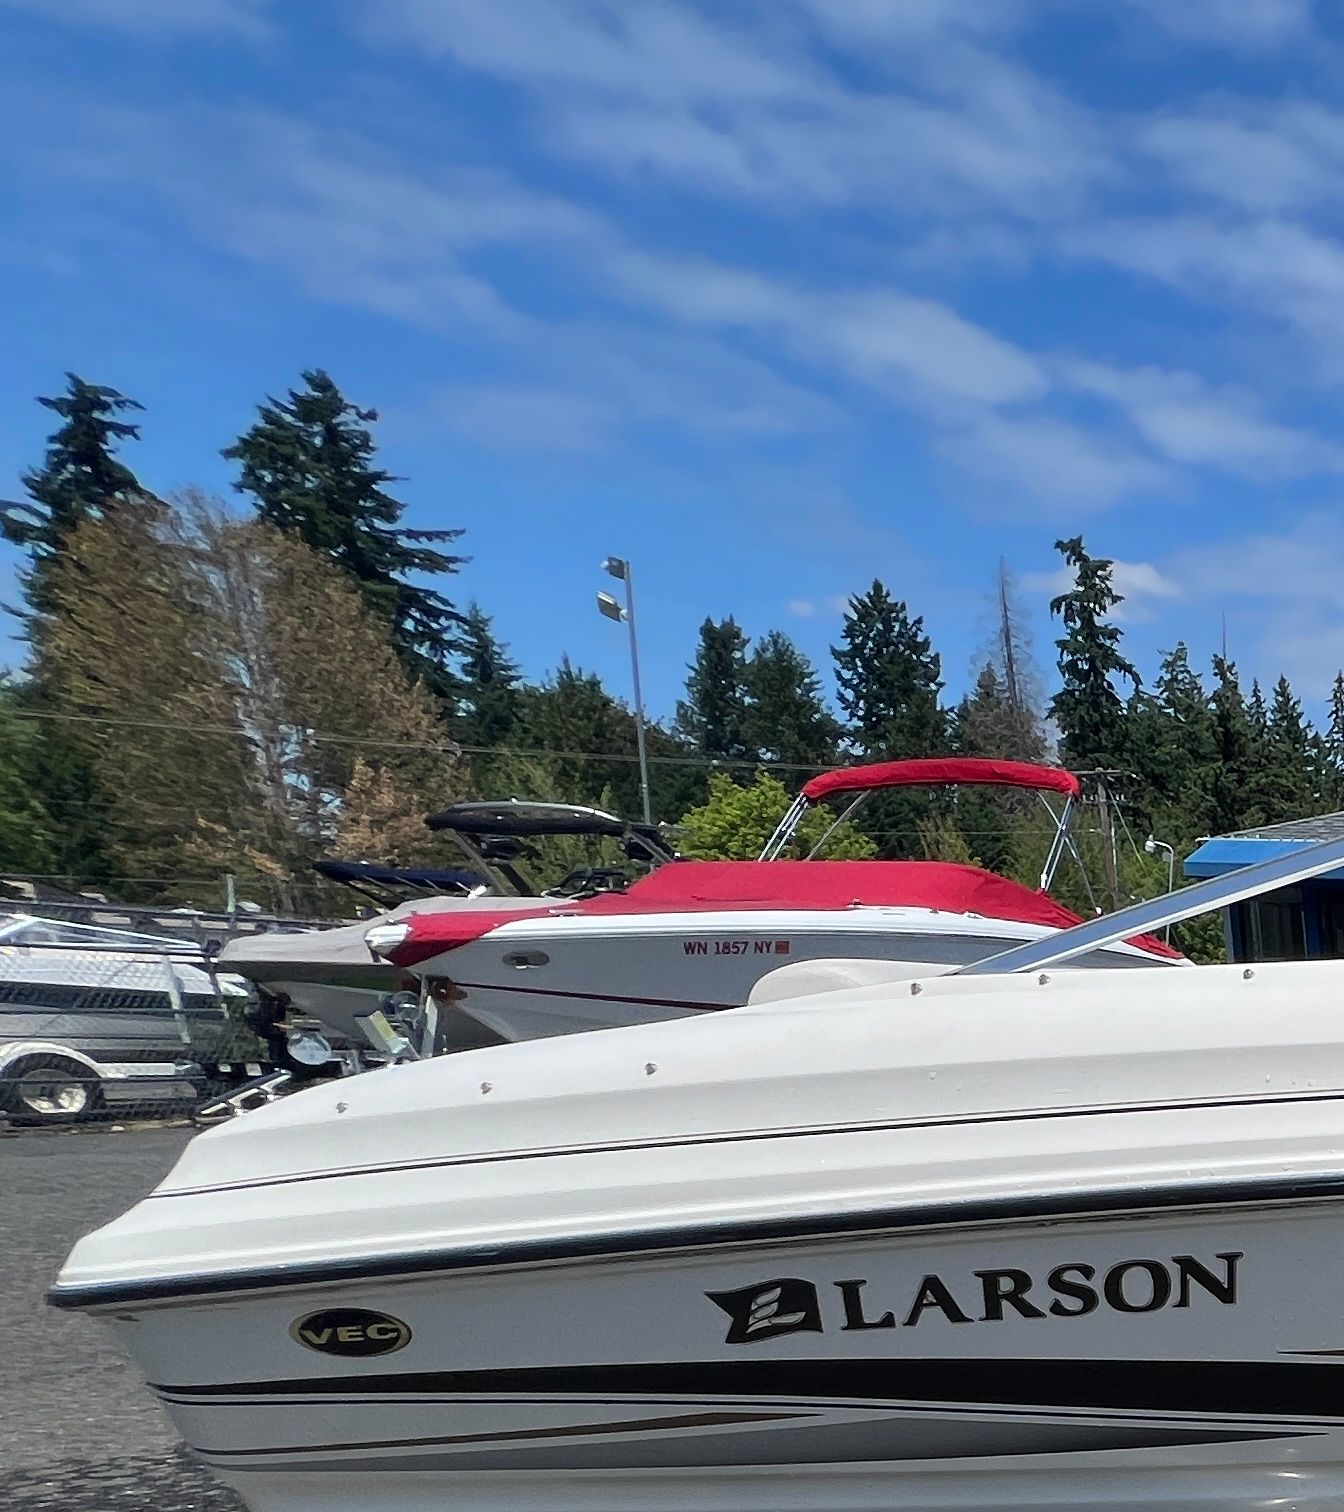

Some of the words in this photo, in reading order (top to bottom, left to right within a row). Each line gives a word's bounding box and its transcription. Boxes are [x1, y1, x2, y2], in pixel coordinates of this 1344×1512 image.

[683, 941, 708, 955] WN
[714, 941, 749, 955] 1857
[753, 940, 773, 954] NY
[833, 1251, 1245, 1331] LARSON
[302, 1323, 399, 1345] VEC
